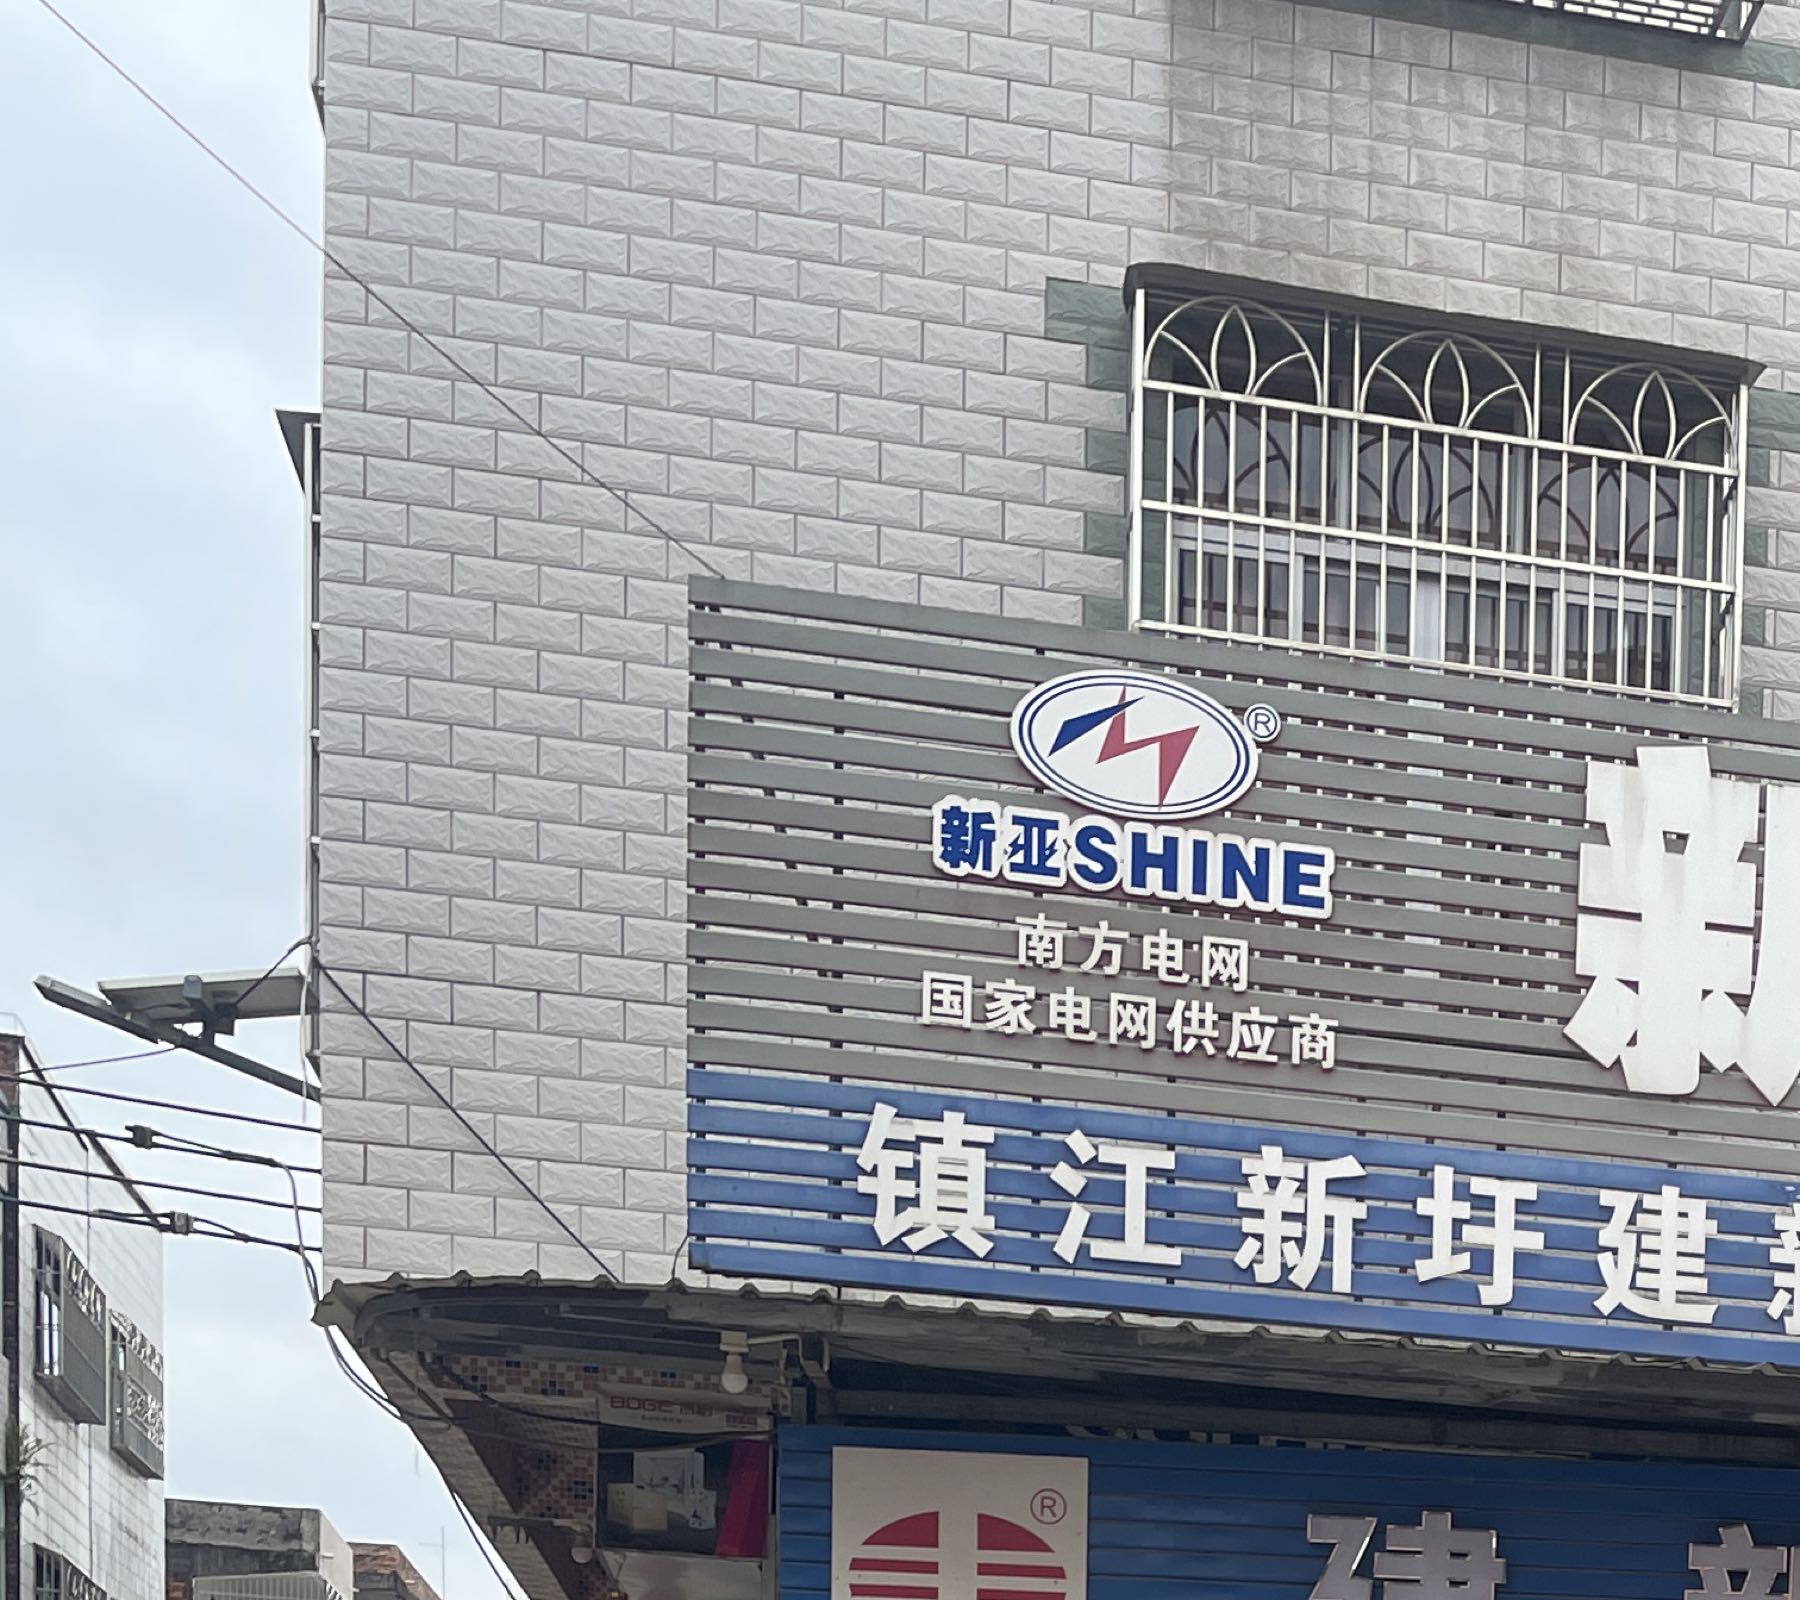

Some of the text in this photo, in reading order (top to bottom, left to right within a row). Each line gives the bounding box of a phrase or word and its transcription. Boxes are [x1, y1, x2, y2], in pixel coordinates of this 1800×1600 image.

[1014, 912, 1251, 994] 南方电网
[920, 970, 1340, 1070] 国家电网供应商
